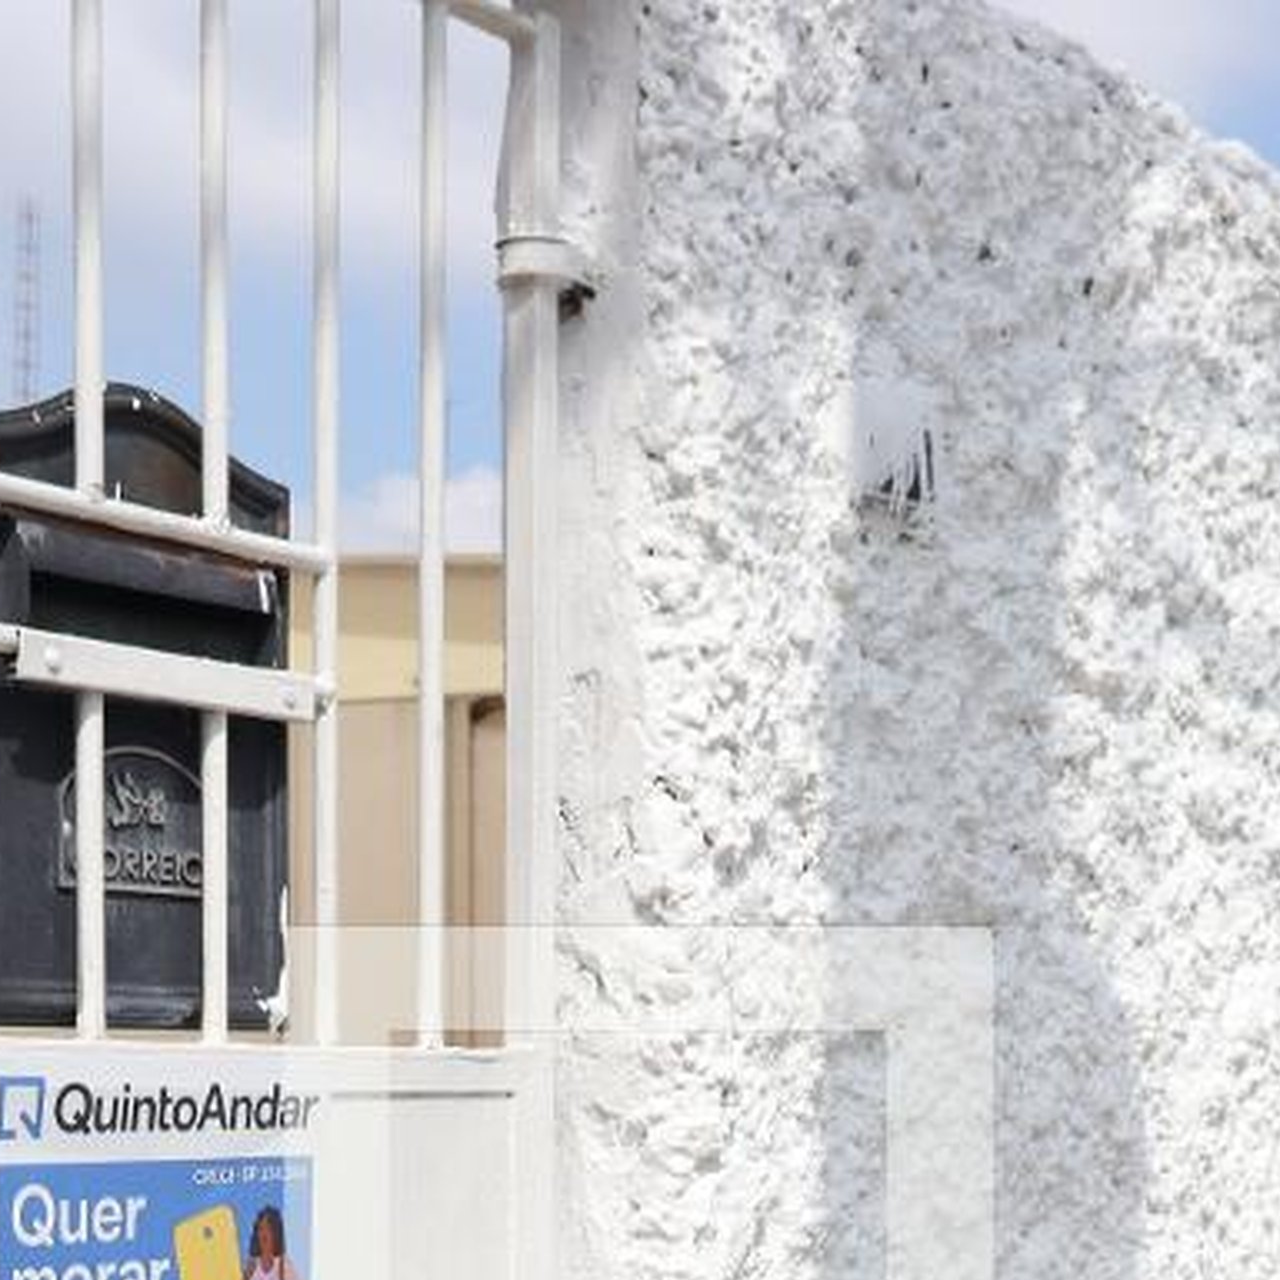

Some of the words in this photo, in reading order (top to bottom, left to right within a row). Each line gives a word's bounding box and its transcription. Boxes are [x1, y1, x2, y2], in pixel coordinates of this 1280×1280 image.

[74, 846, 203, 886] ORREIO
[53, 1082, 319, 1135] QuintoAndar
[12, 1184, 147, 1247] Quer
